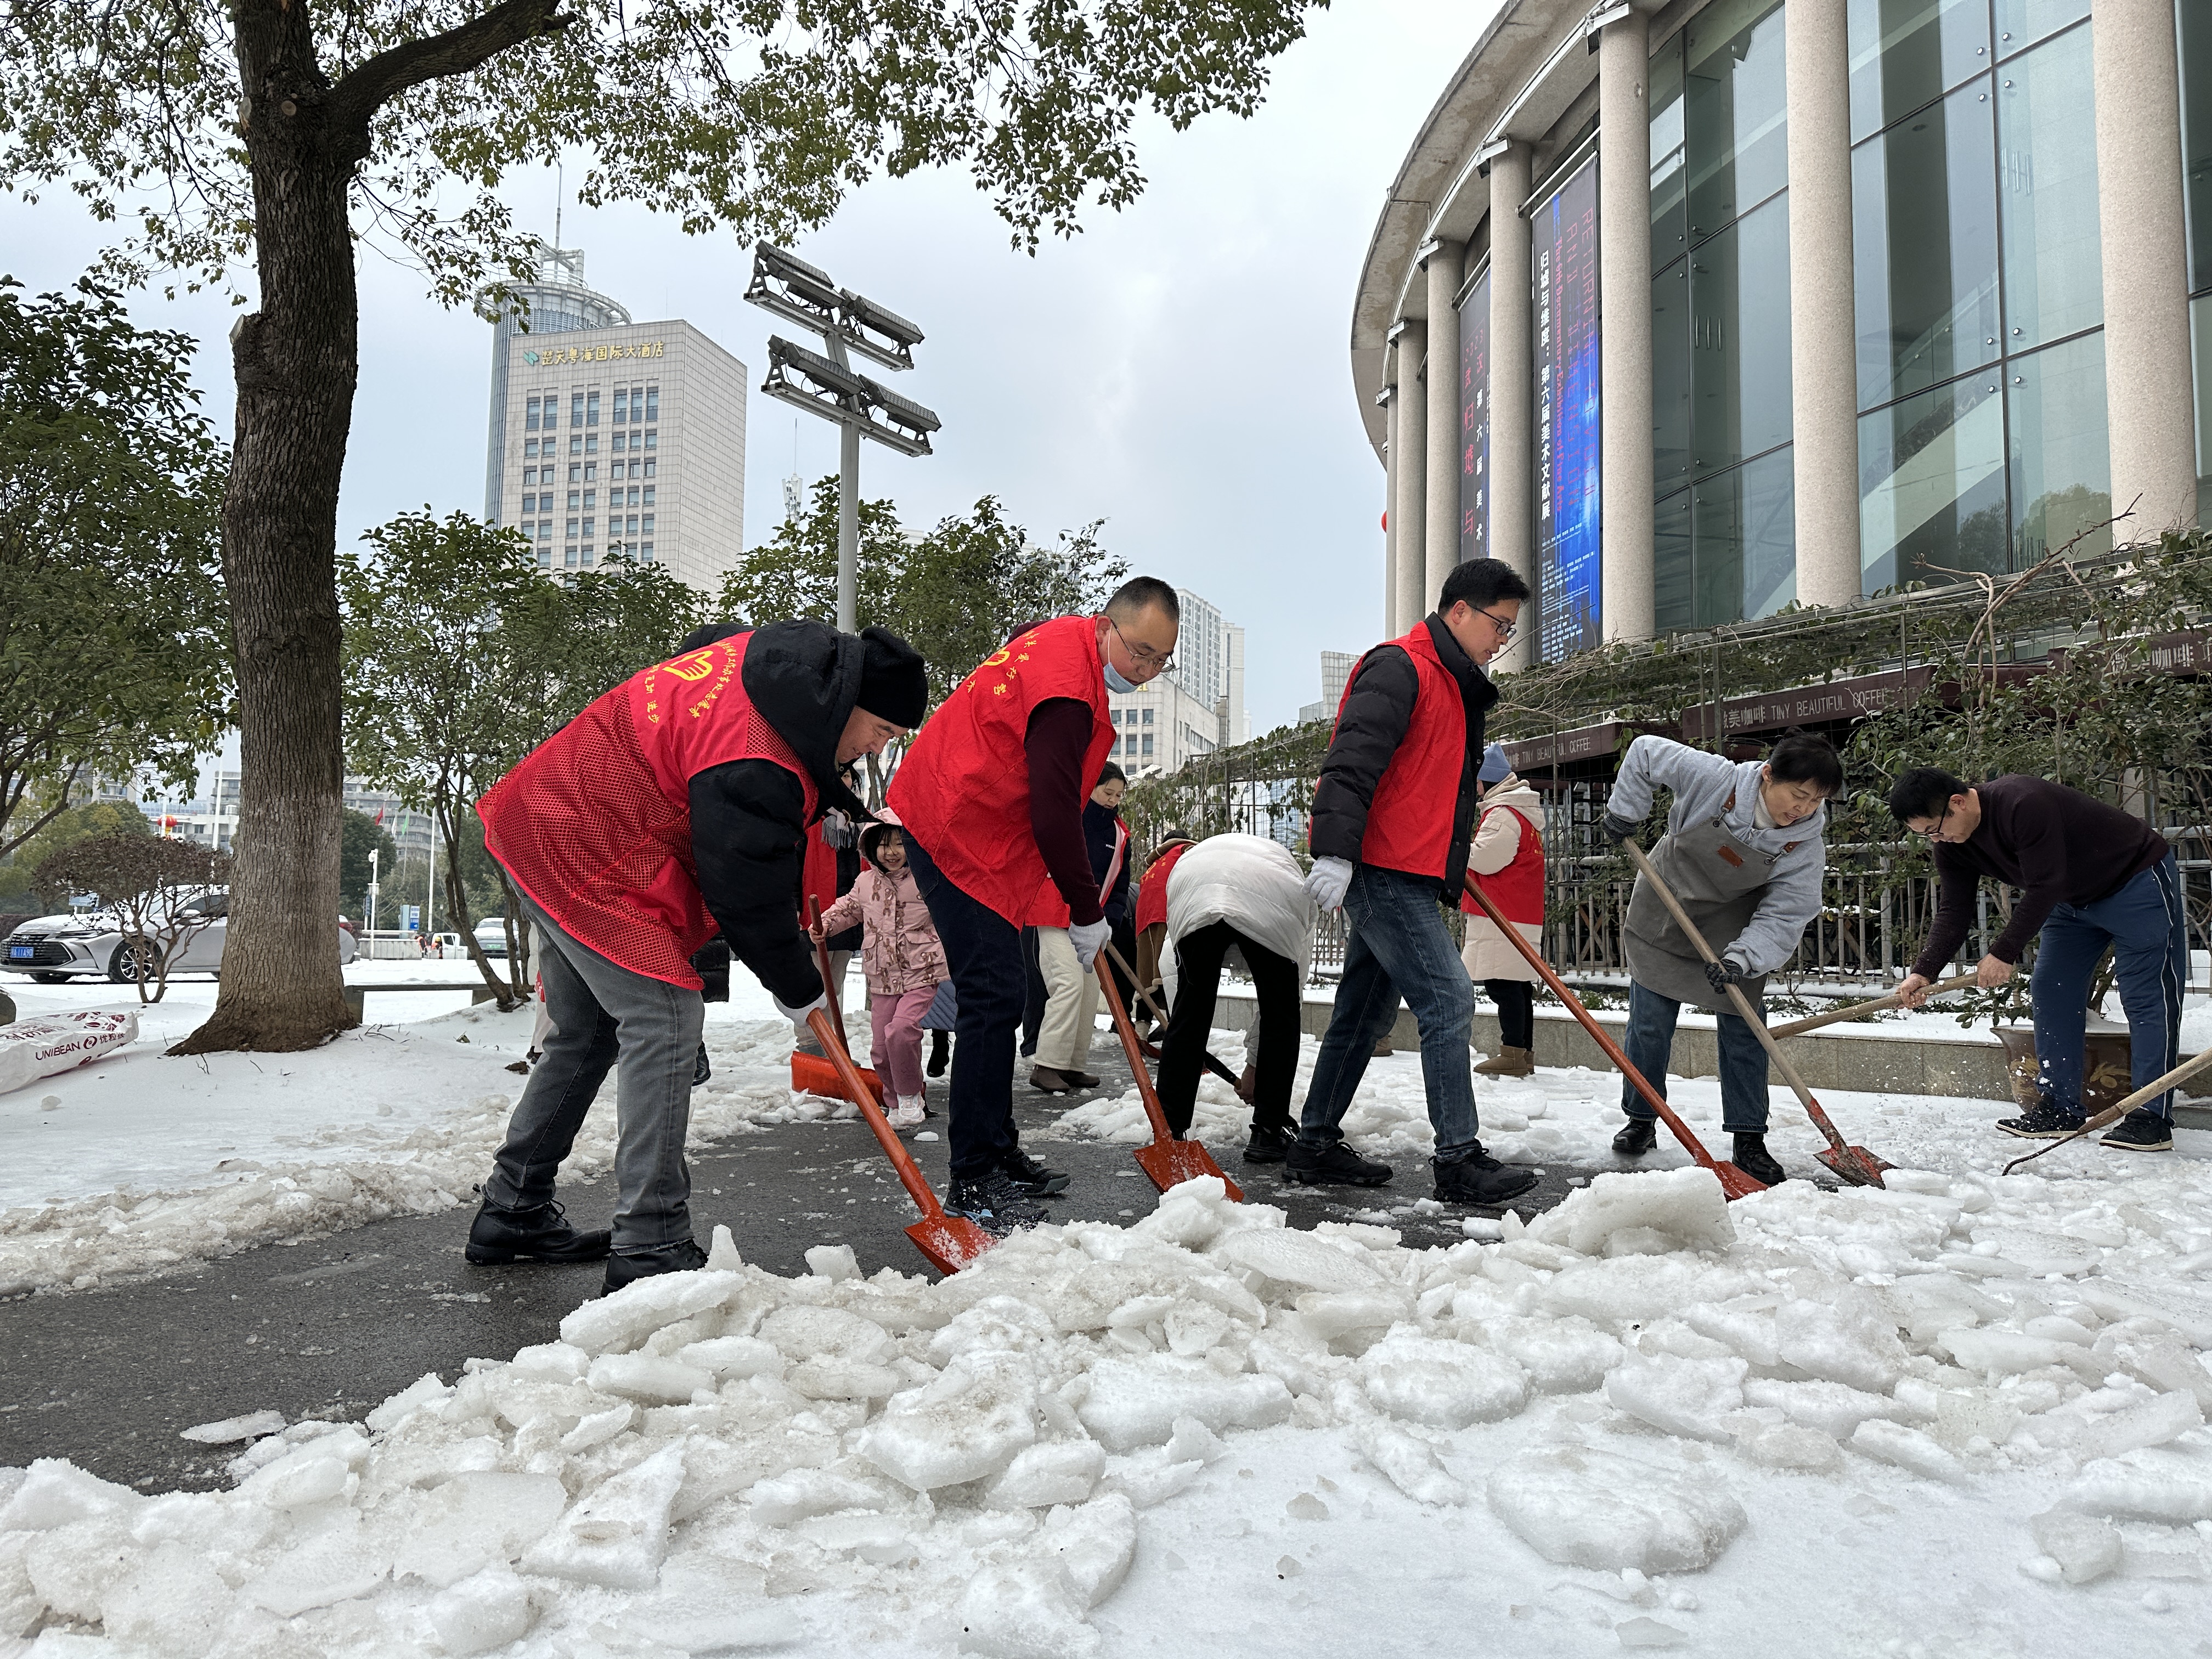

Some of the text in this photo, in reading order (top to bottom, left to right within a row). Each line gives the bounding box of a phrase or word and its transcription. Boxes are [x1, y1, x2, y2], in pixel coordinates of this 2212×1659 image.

[541, 340, 665, 366] 楚天粤海国际大酒店
[1770, 703, 1791, 720] TINY
[1796, 695, 1846, 716] BEAUTIFUL
[1522, 750, 1534, 764] TINY
[1570, 737, 1590, 753] COFFEE
[35, 1041, 81, 1060] UNIBEAN
